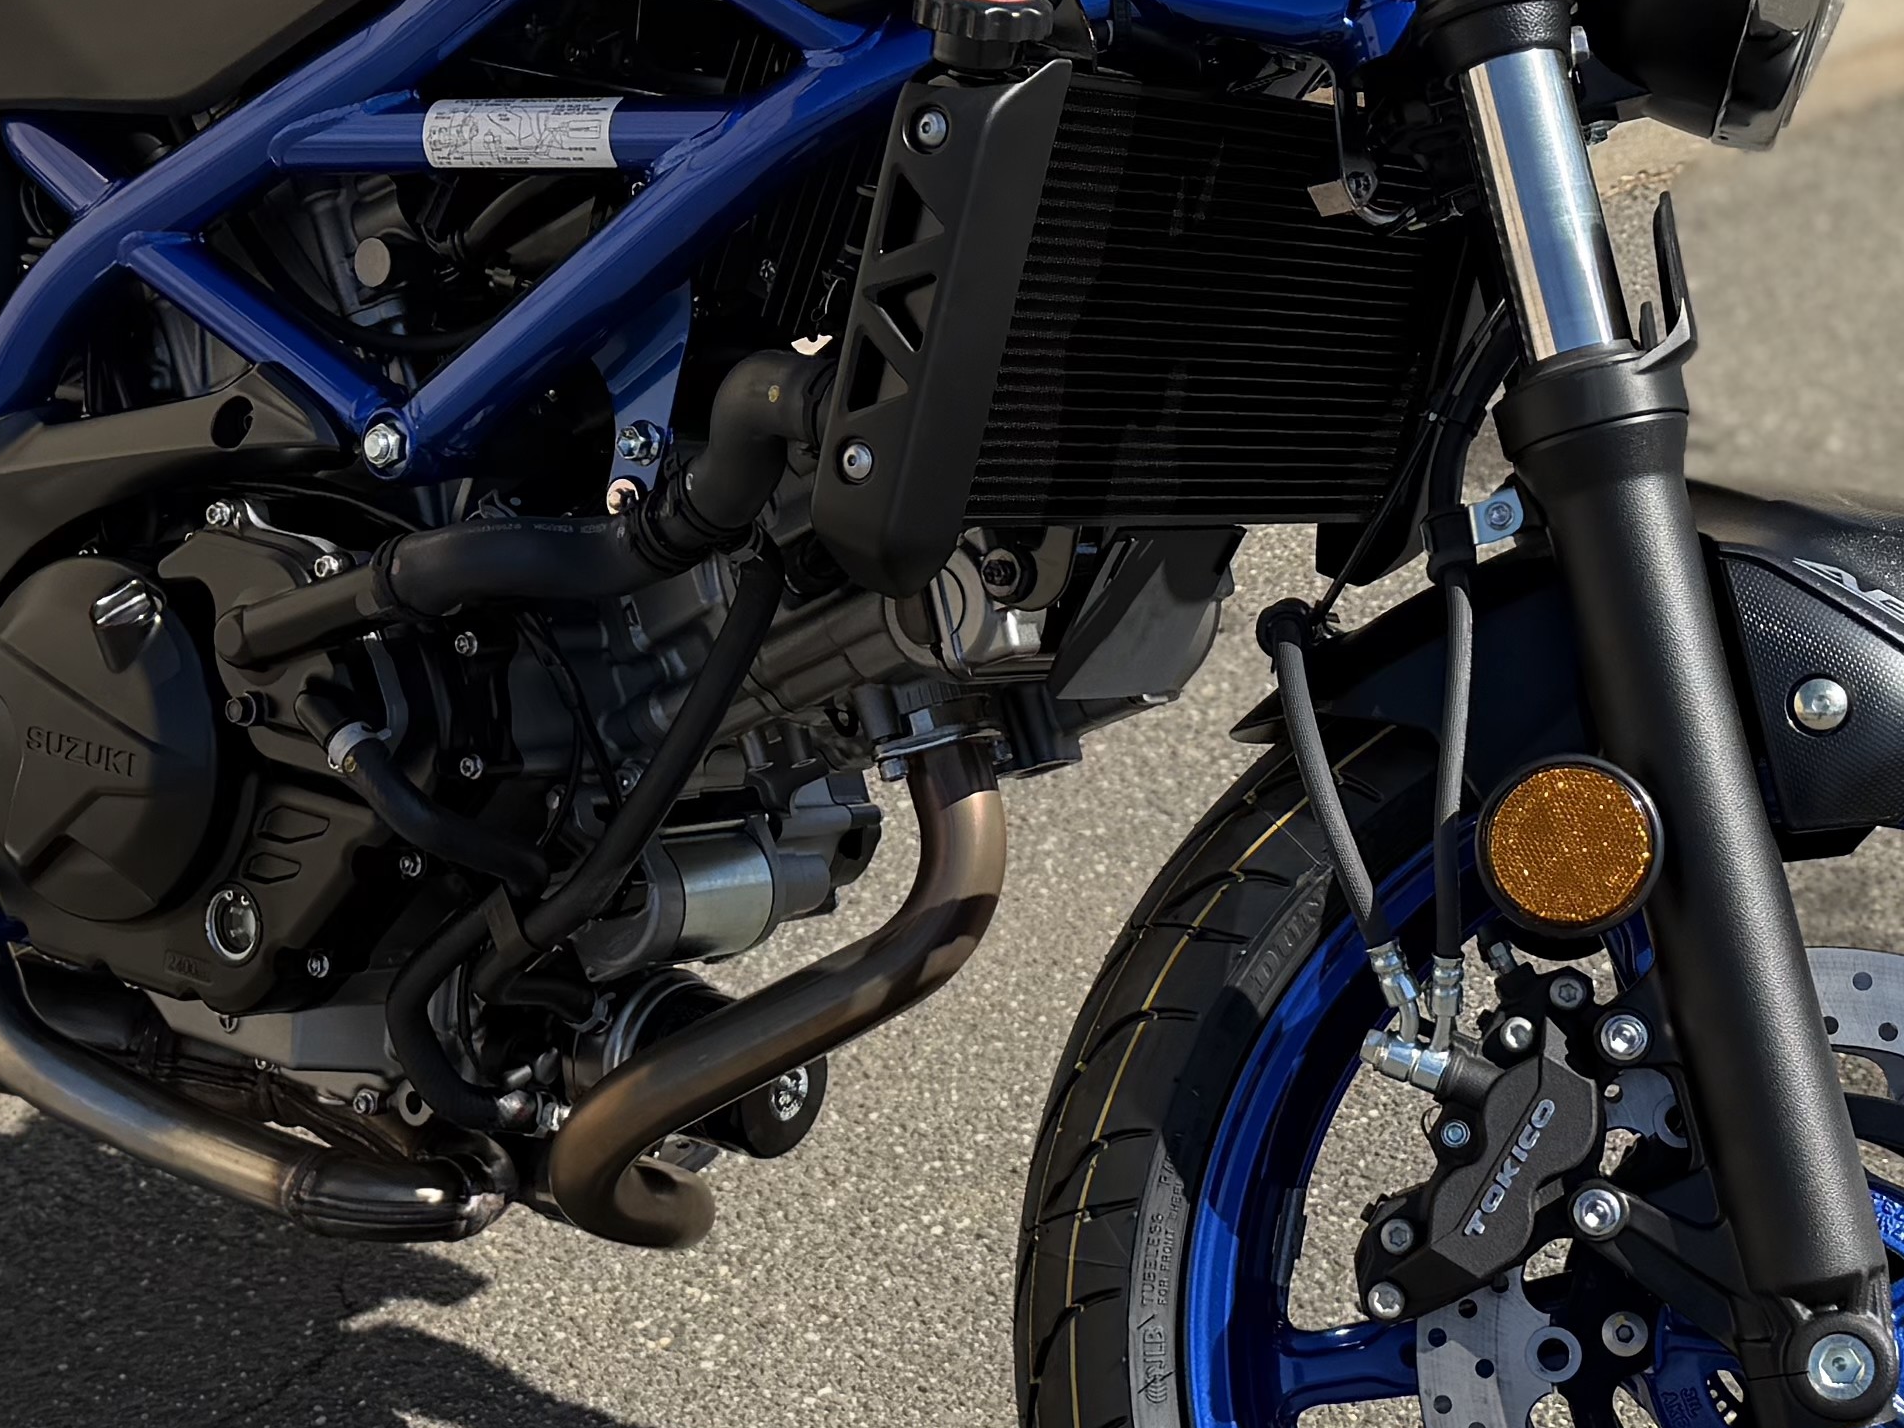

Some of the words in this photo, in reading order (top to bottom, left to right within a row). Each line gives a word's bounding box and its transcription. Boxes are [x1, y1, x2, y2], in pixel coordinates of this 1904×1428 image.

[25, 724, 137, 778] SUZUKI
[1463, 1098, 1556, 1237] TOKICO
[1141, 1212, 1165, 1307] TUBELESS
[1160, 1228, 1176, 1272] FRONT
